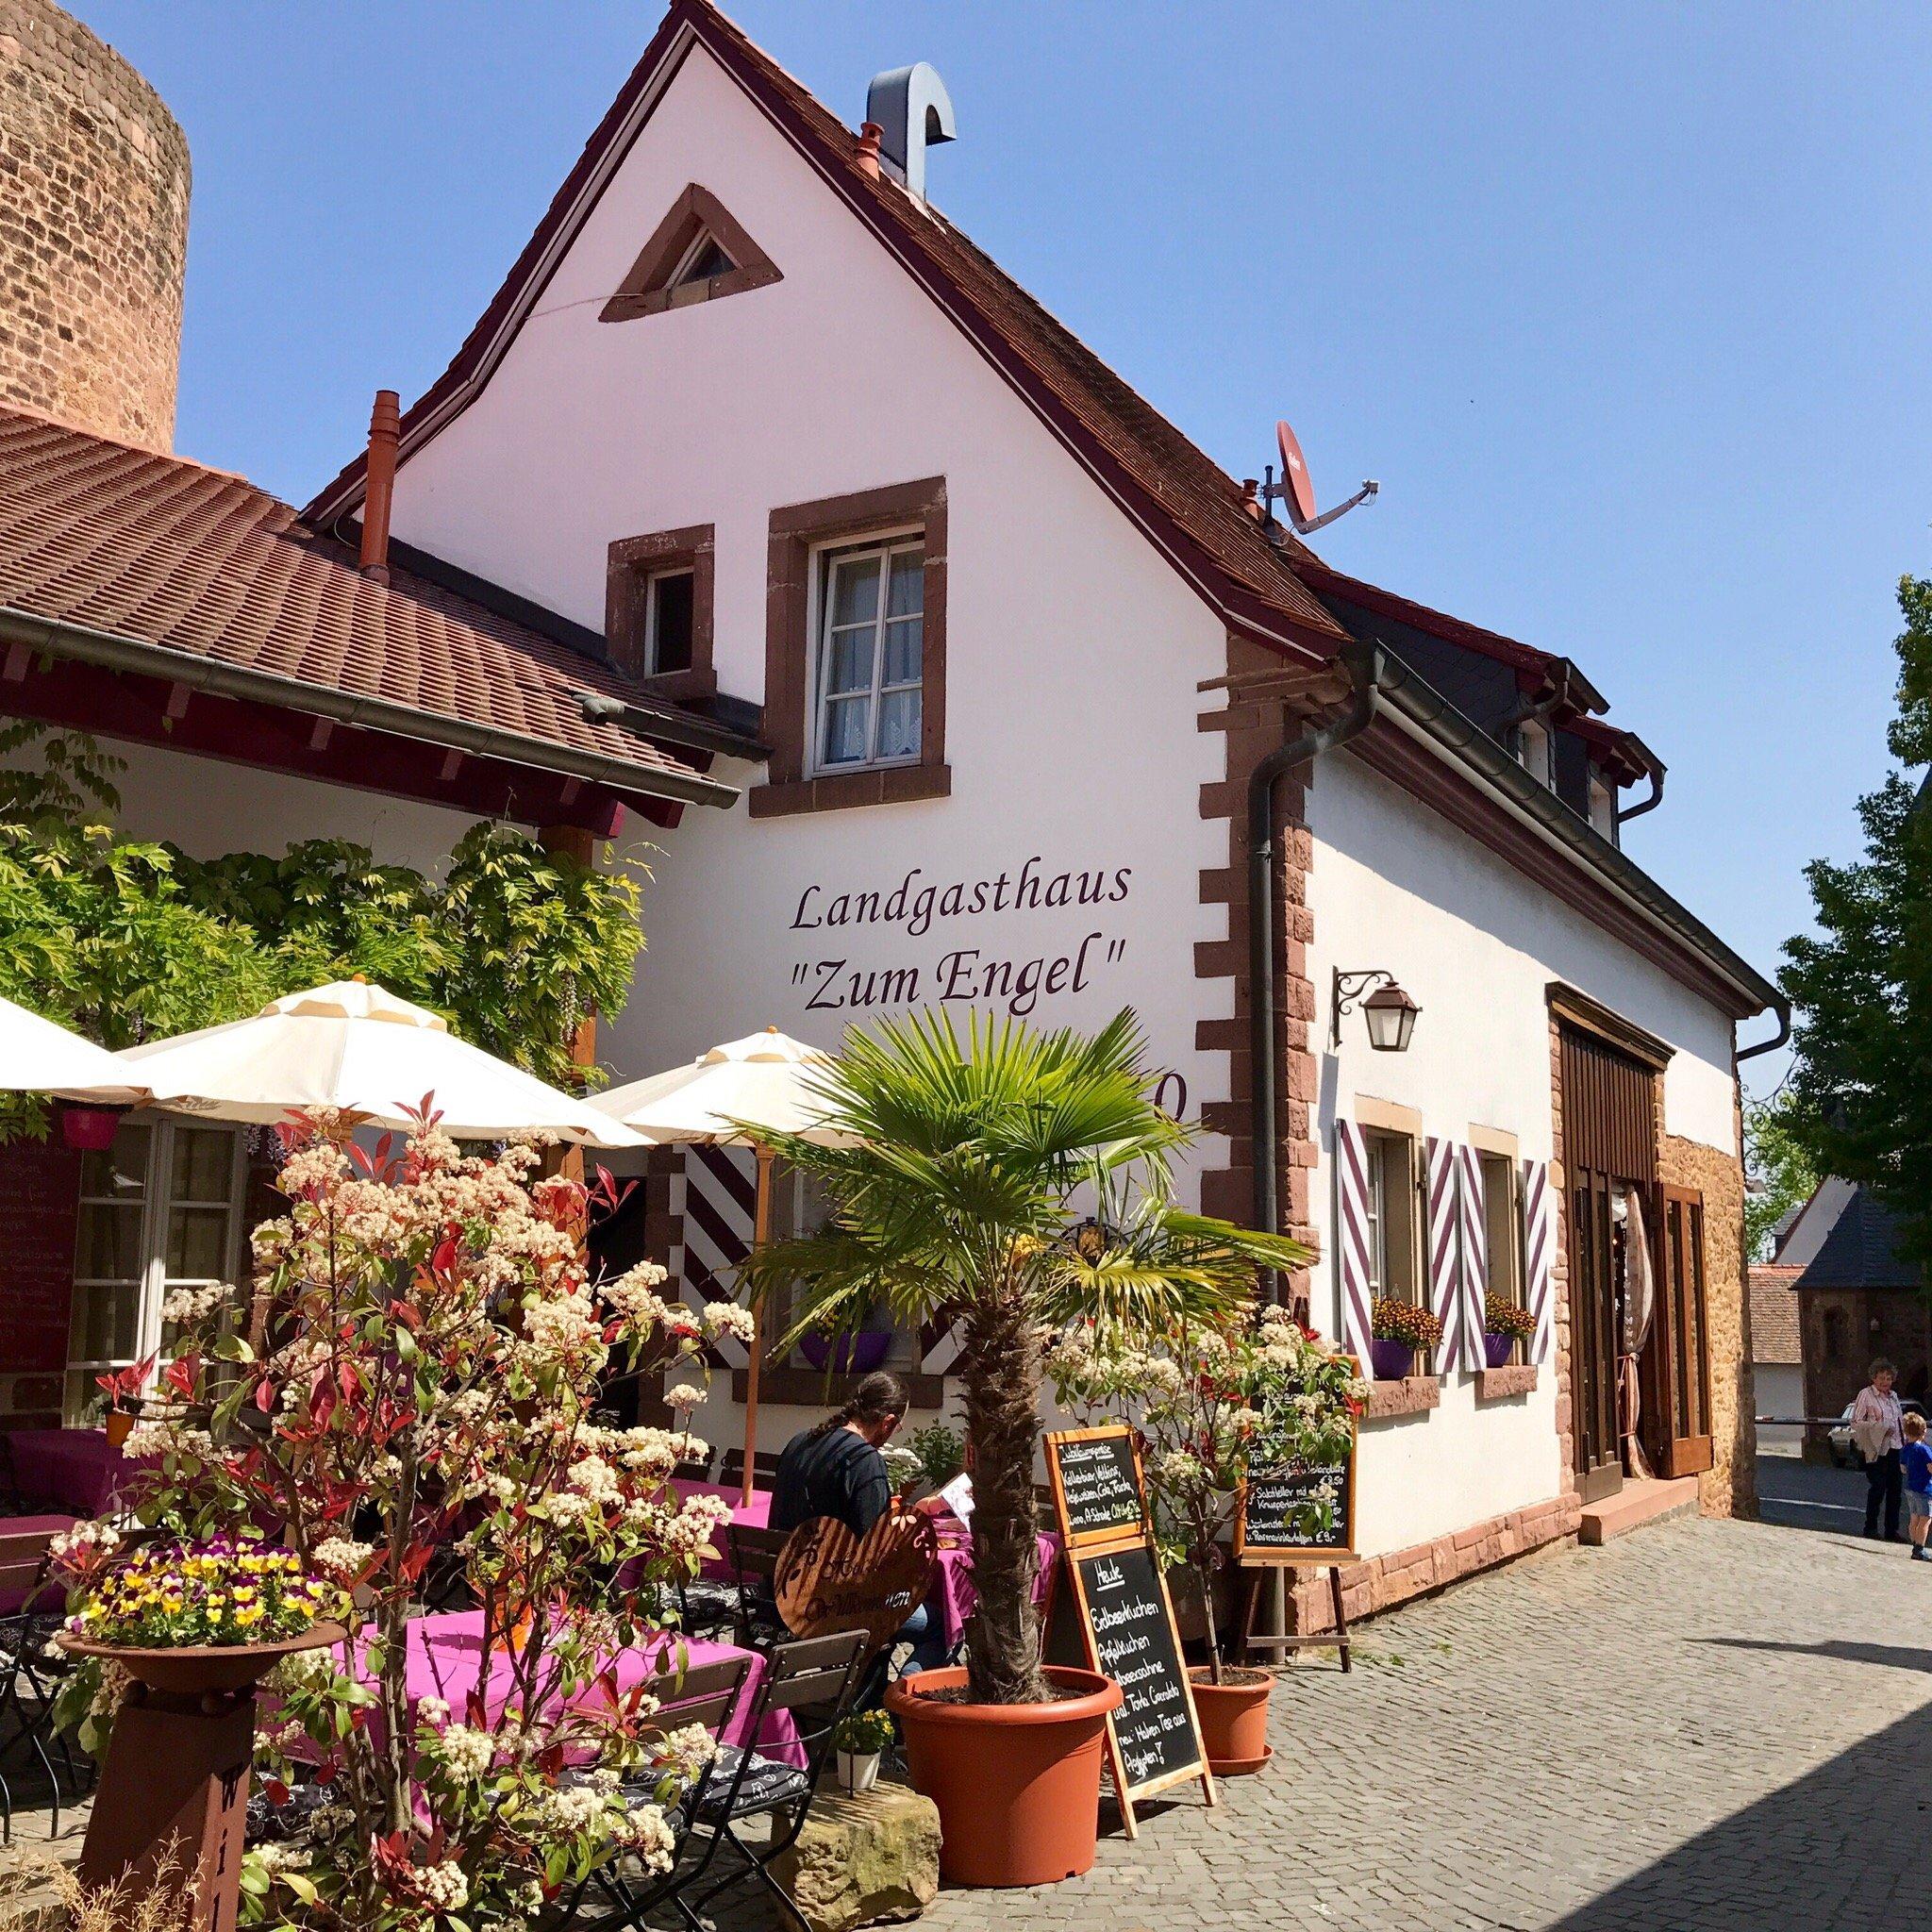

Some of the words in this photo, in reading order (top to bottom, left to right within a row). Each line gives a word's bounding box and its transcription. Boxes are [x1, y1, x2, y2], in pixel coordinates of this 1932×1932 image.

[789, 856, 1133, 936] Landgasthaus
[791, 958, 920, 1011] "Zum
[936, 932, 1126, 1016] Engel"
[1094, 1558, 1124, 1586] Heute
